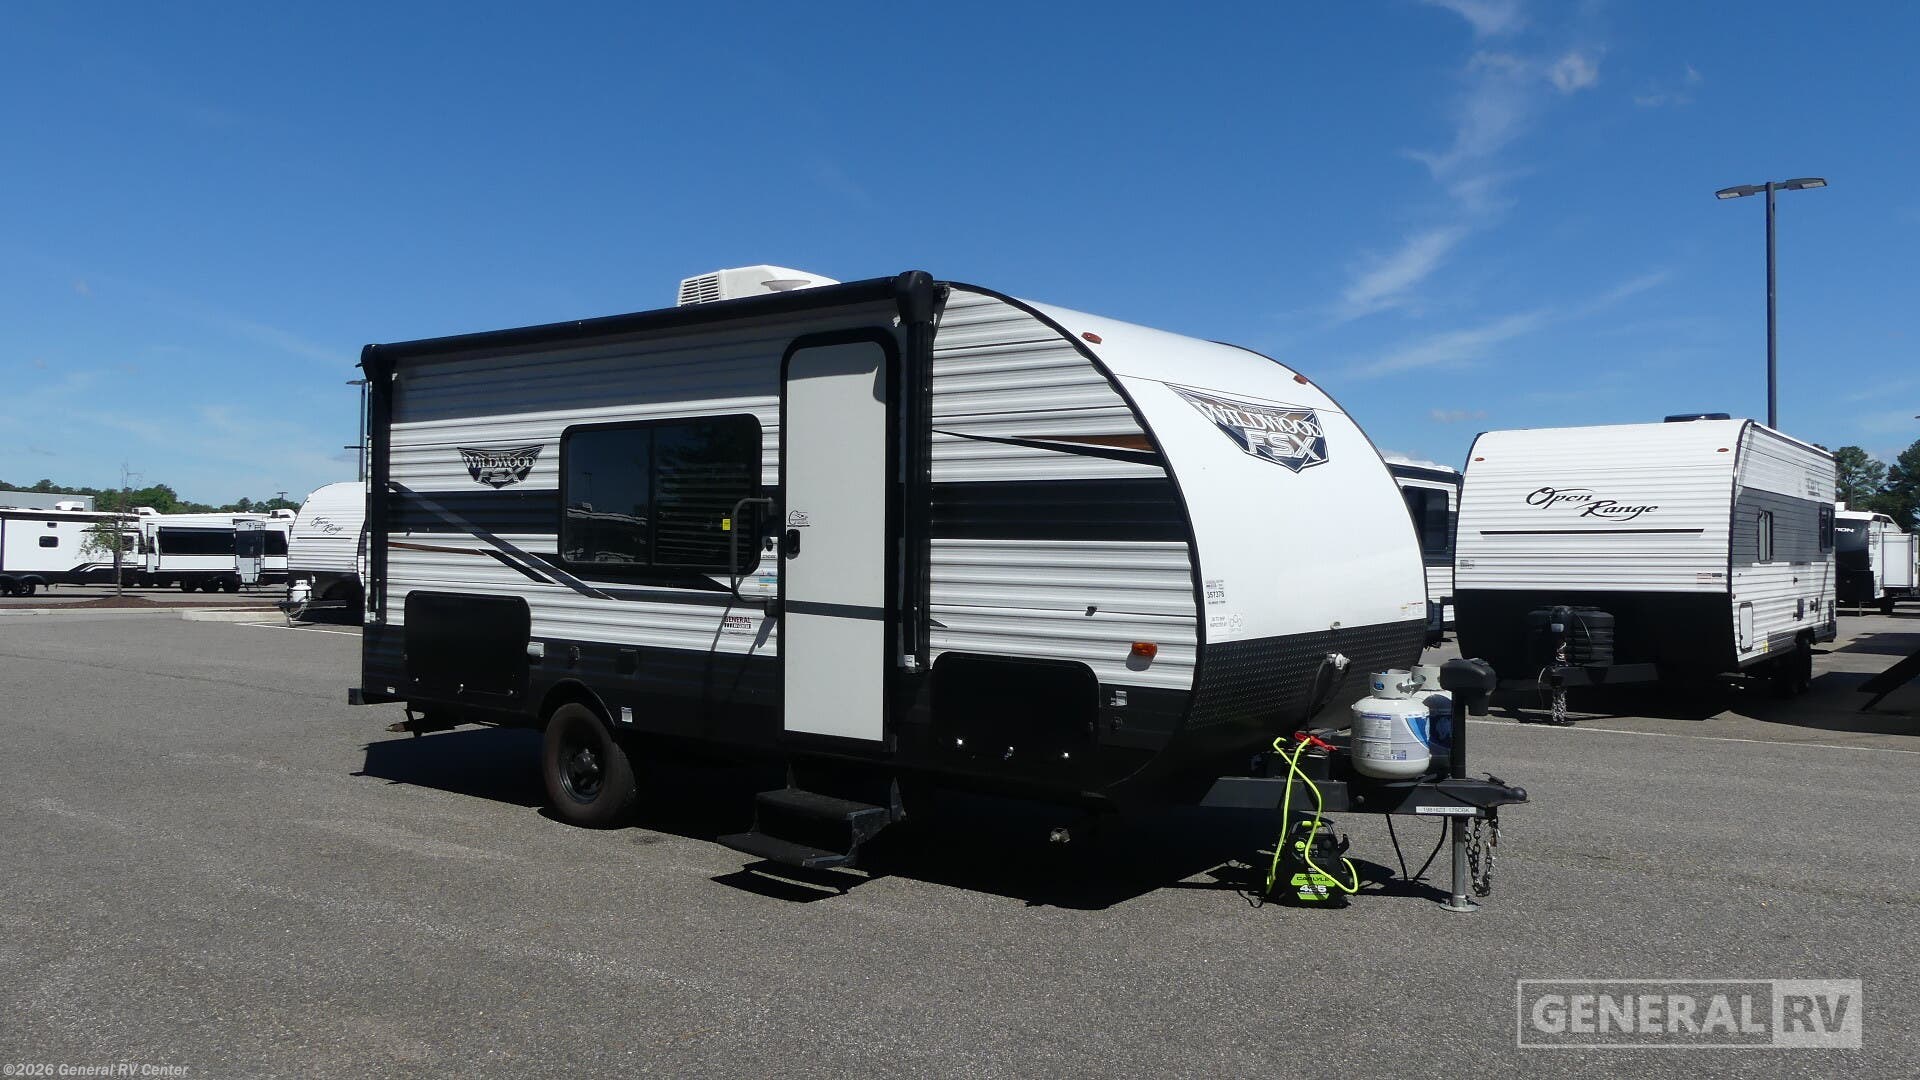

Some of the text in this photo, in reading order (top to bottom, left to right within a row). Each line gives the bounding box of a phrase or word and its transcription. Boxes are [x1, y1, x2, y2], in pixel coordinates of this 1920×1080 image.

[1201, 404, 1324, 437] WILDWOOD
[1244, 428, 1322, 460] FSX
[463, 455, 536, 468] WILDWOOD
[1526, 487, 1595, 509] Open
[1574, 500, 1658, 521] Range
